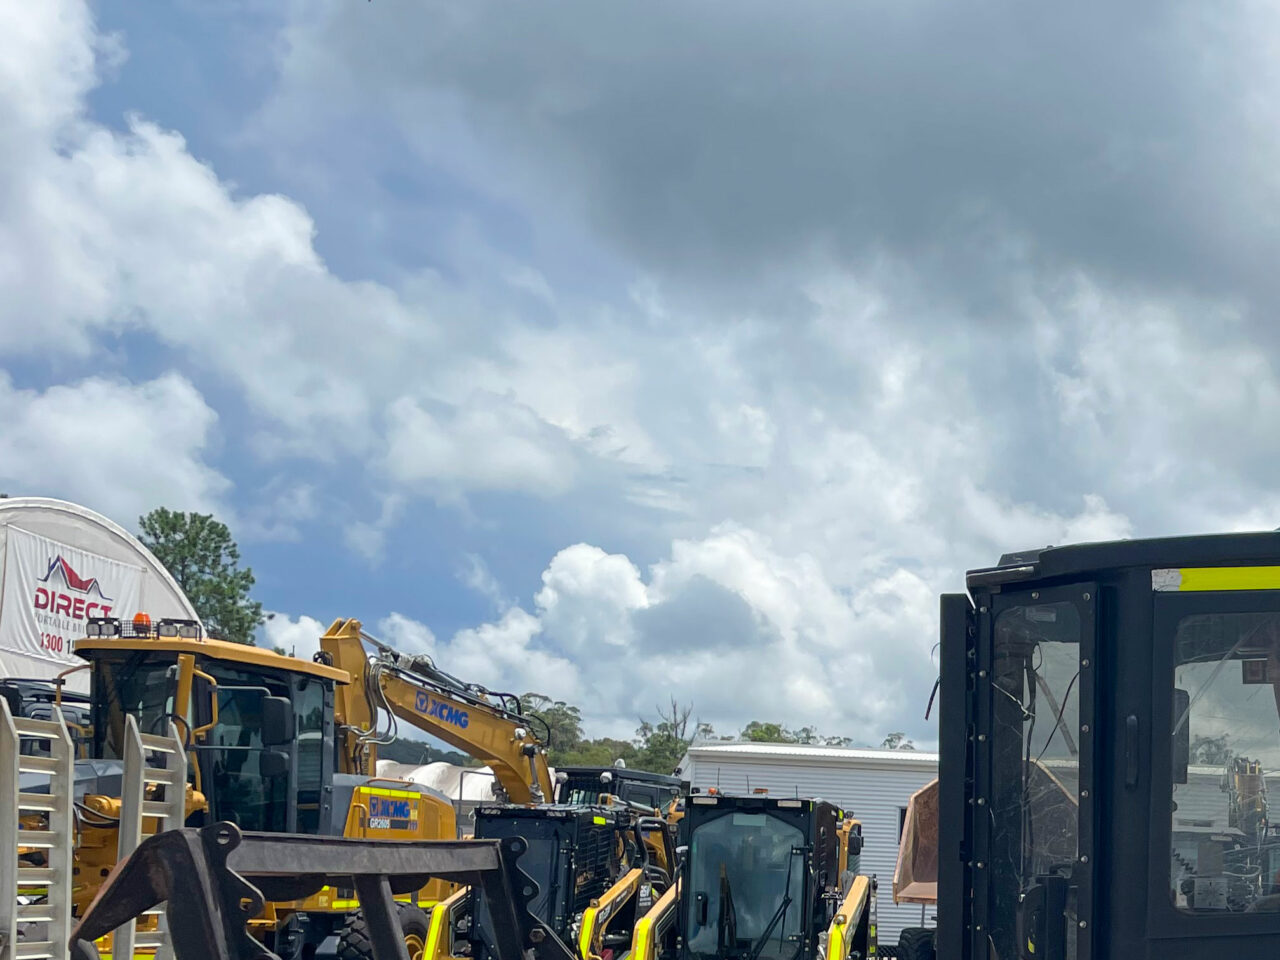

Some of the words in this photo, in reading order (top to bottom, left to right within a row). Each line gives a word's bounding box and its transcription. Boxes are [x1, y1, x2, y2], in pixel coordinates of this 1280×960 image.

[34, 587, 112, 619] DIRECT
[41, 632, 63, 653] 1300
[429, 699, 469, 729] XCMG
[380, 799, 411, 819] XCMG
